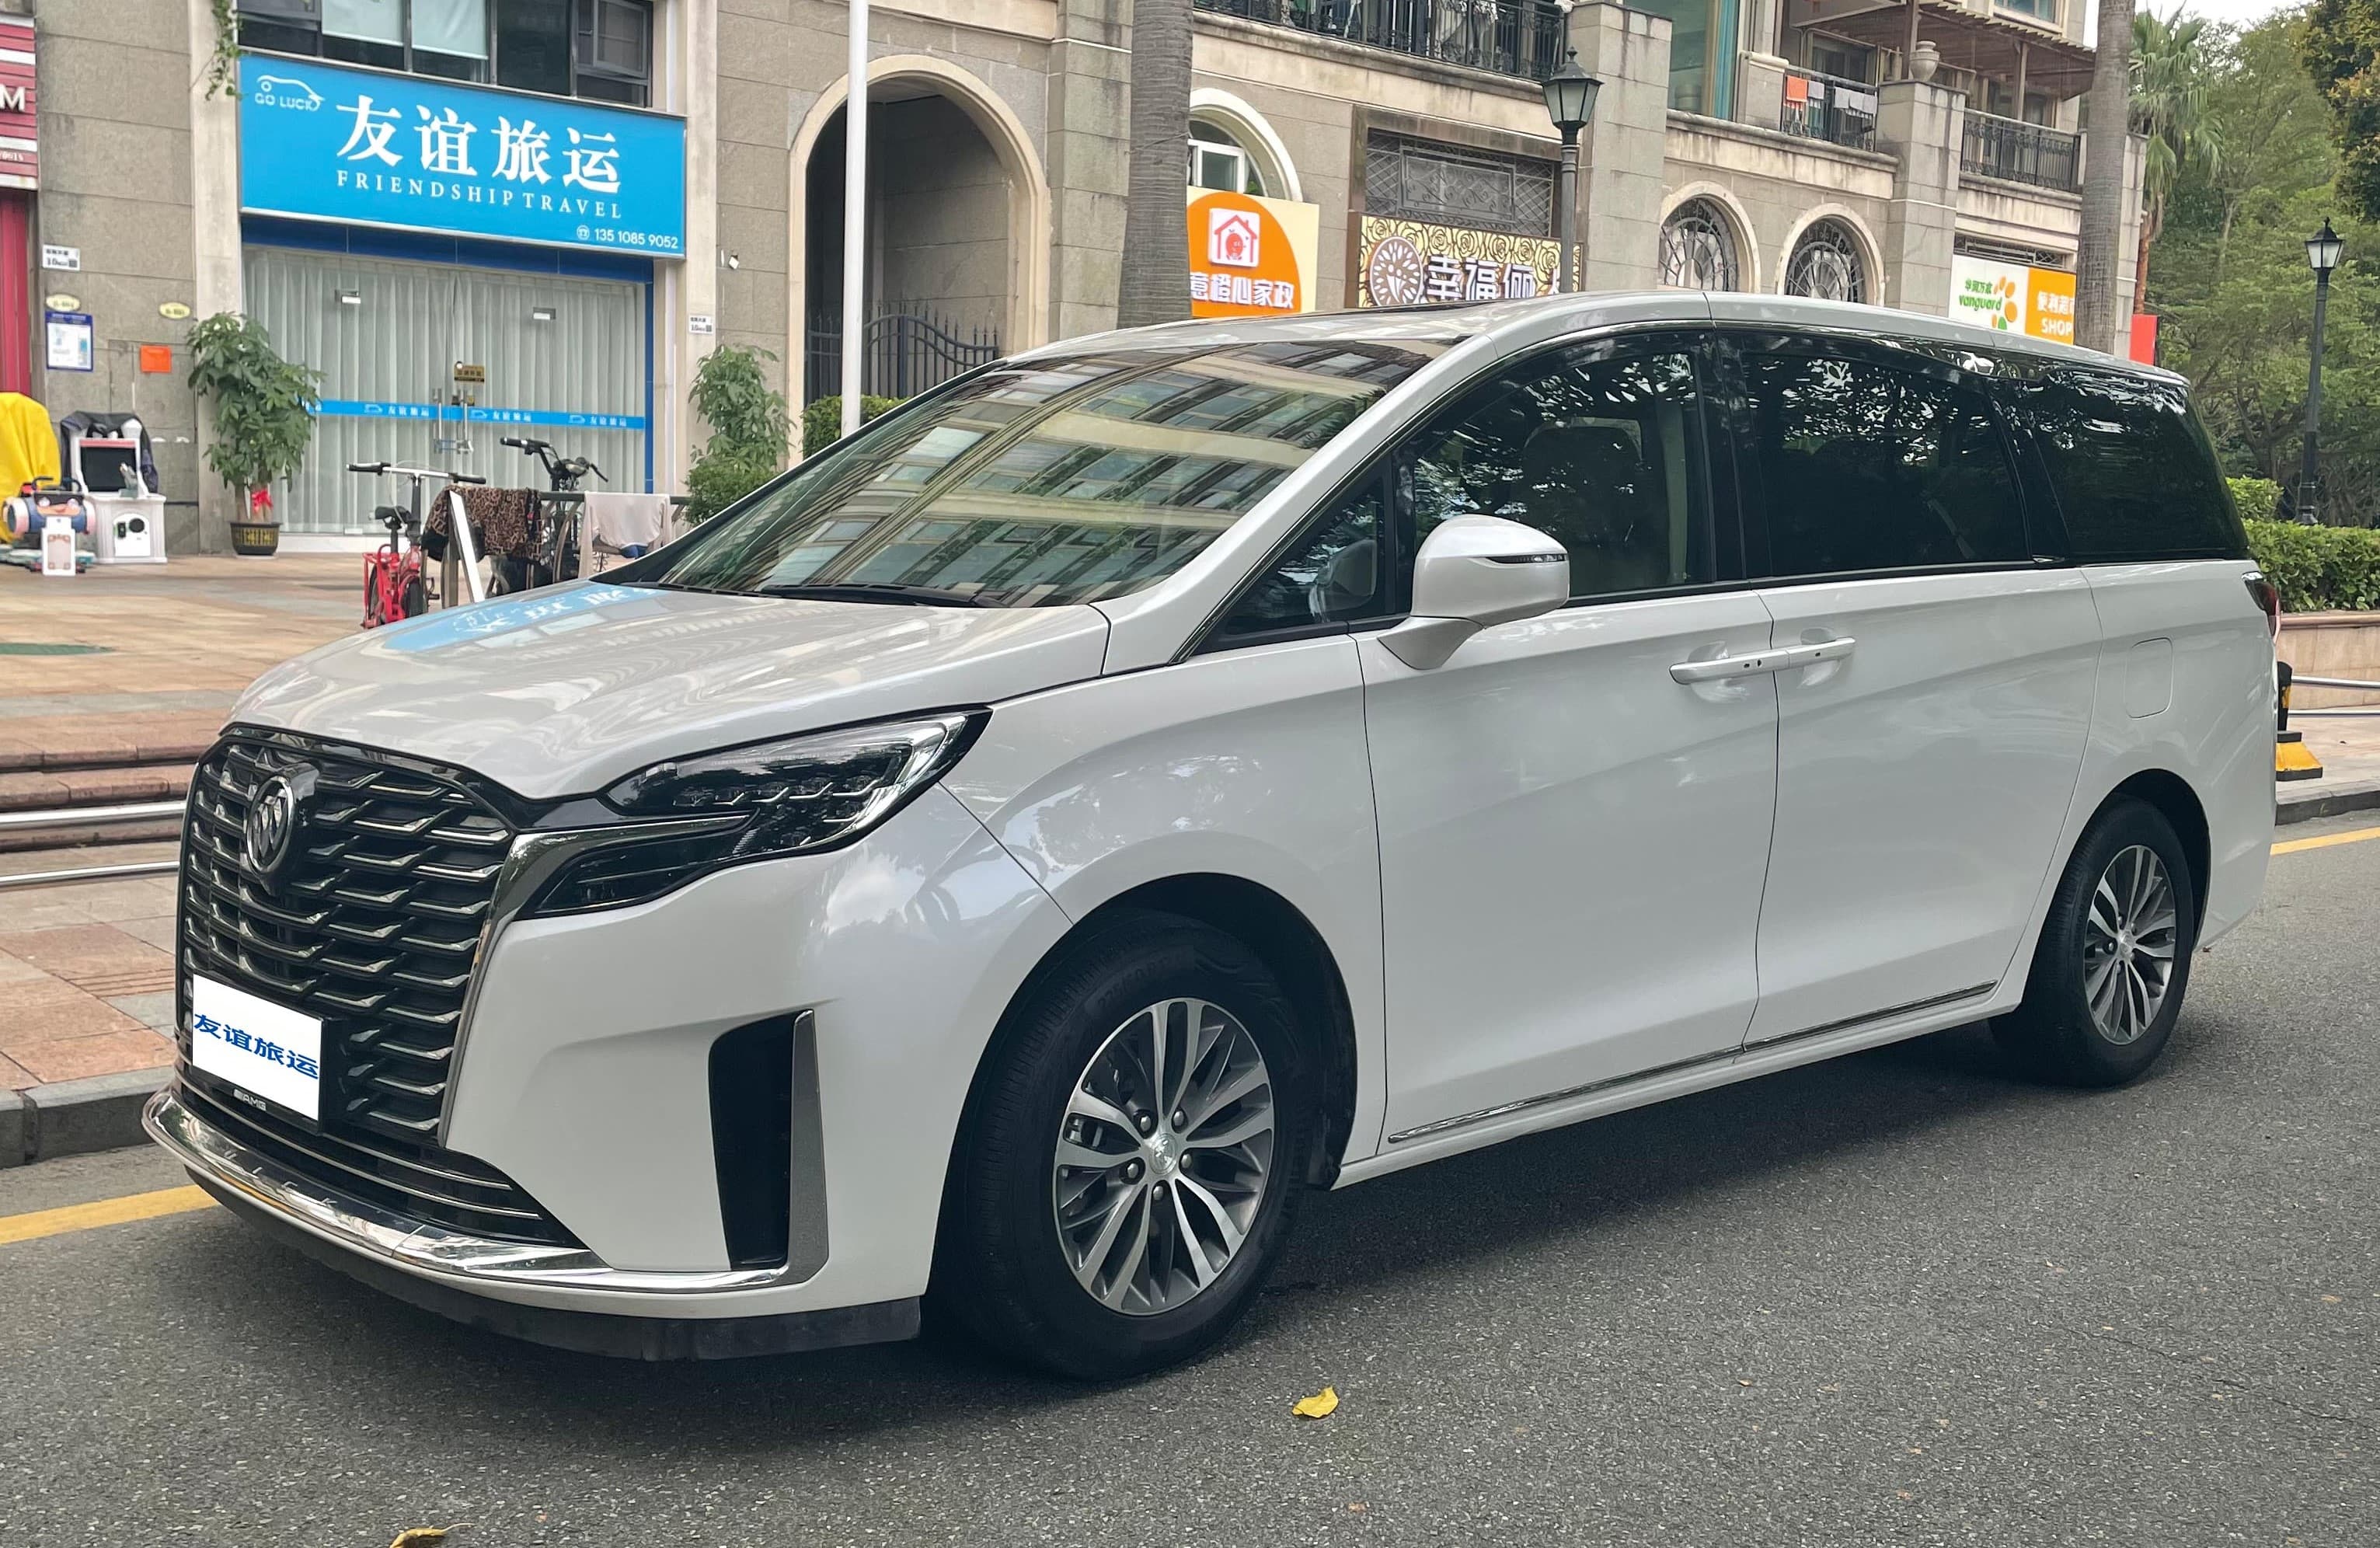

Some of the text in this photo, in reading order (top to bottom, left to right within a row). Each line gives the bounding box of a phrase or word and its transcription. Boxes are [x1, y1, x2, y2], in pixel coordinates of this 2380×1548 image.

[254, 92, 275, 106] GO
[336, 95, 621, 194] 友谊旅运
[594, 228, 678, 249] 135 1085 9052
[1959, 295, 2002, 311] vanguard
[2040, 317, 2073, 336] SHOP
[193, 1013, 319, 1079] 友谊旅运
[242, 1093, 267, 1111] AMG
